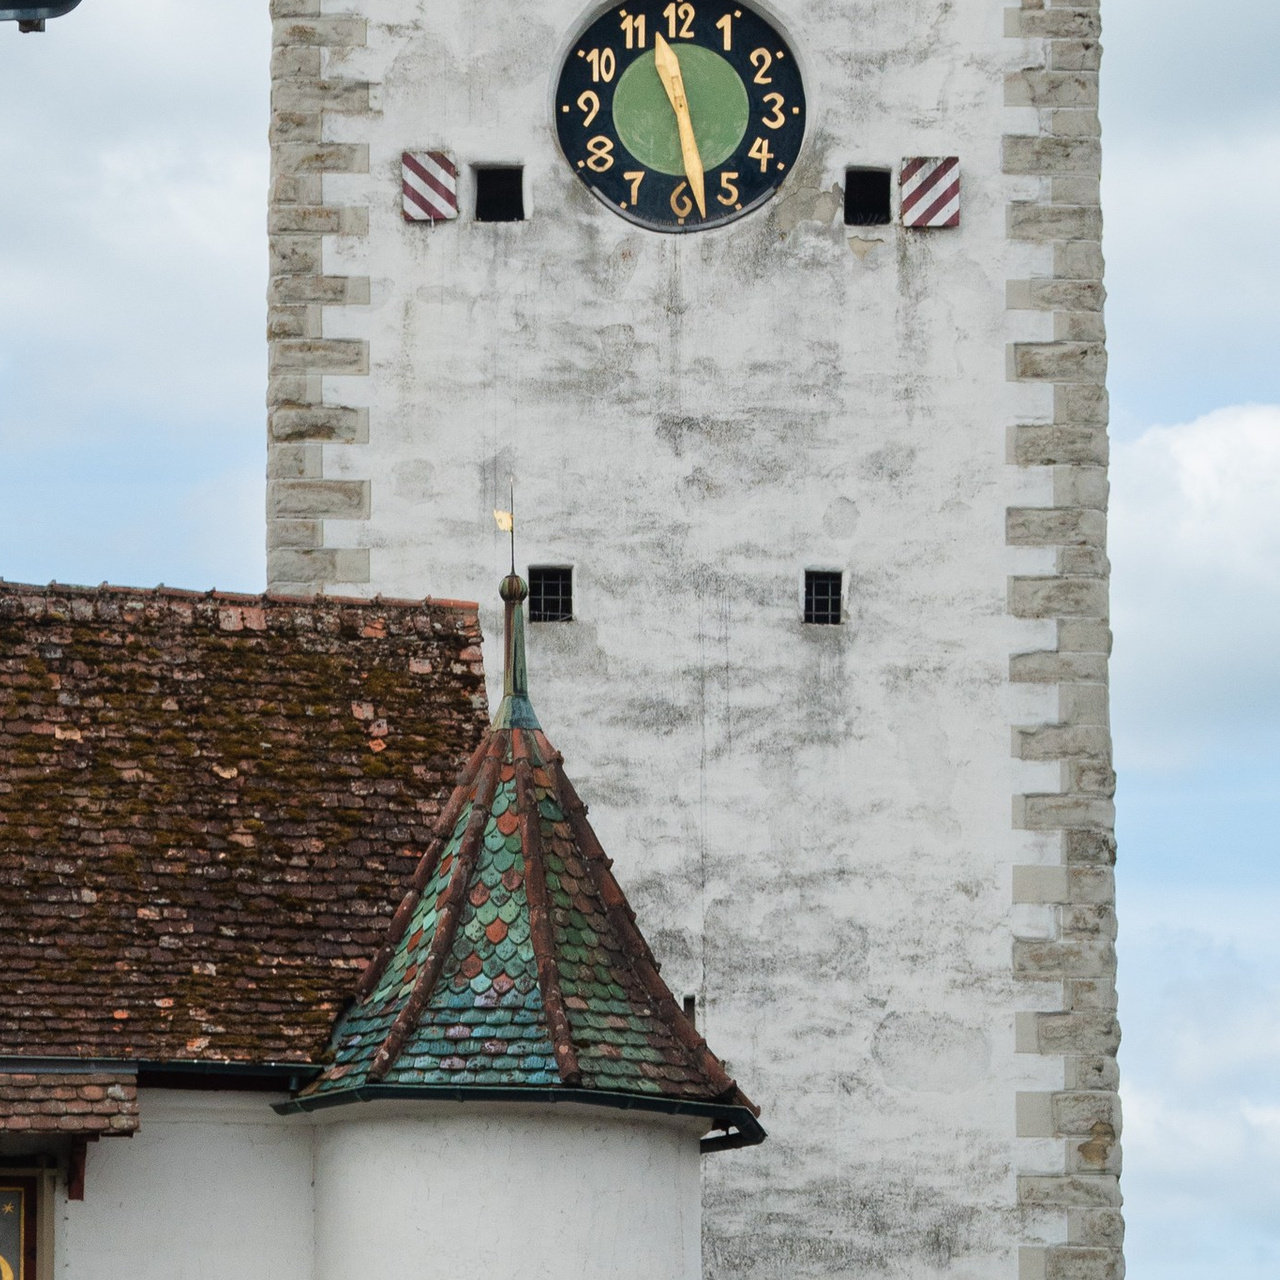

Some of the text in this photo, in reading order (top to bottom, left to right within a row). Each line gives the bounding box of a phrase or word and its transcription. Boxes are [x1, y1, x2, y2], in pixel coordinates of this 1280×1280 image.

[621, 15, 645, 49] 11
[663, 3, 695, 38] 12
[716, 14, 731, 50] 1
[586, 48, 615, 82] 10
[750, 48, 772, 84] 2
[577, 91, 599, 127] 9
[762, 93, 785, 129] 3
[587, 136, 614, 172] 8
[748, 137, 774, 172] 4
[624, 171, 645, 205] 7
[670, 181, 693, 217] 6
[717, 172, 738, 205] 5
